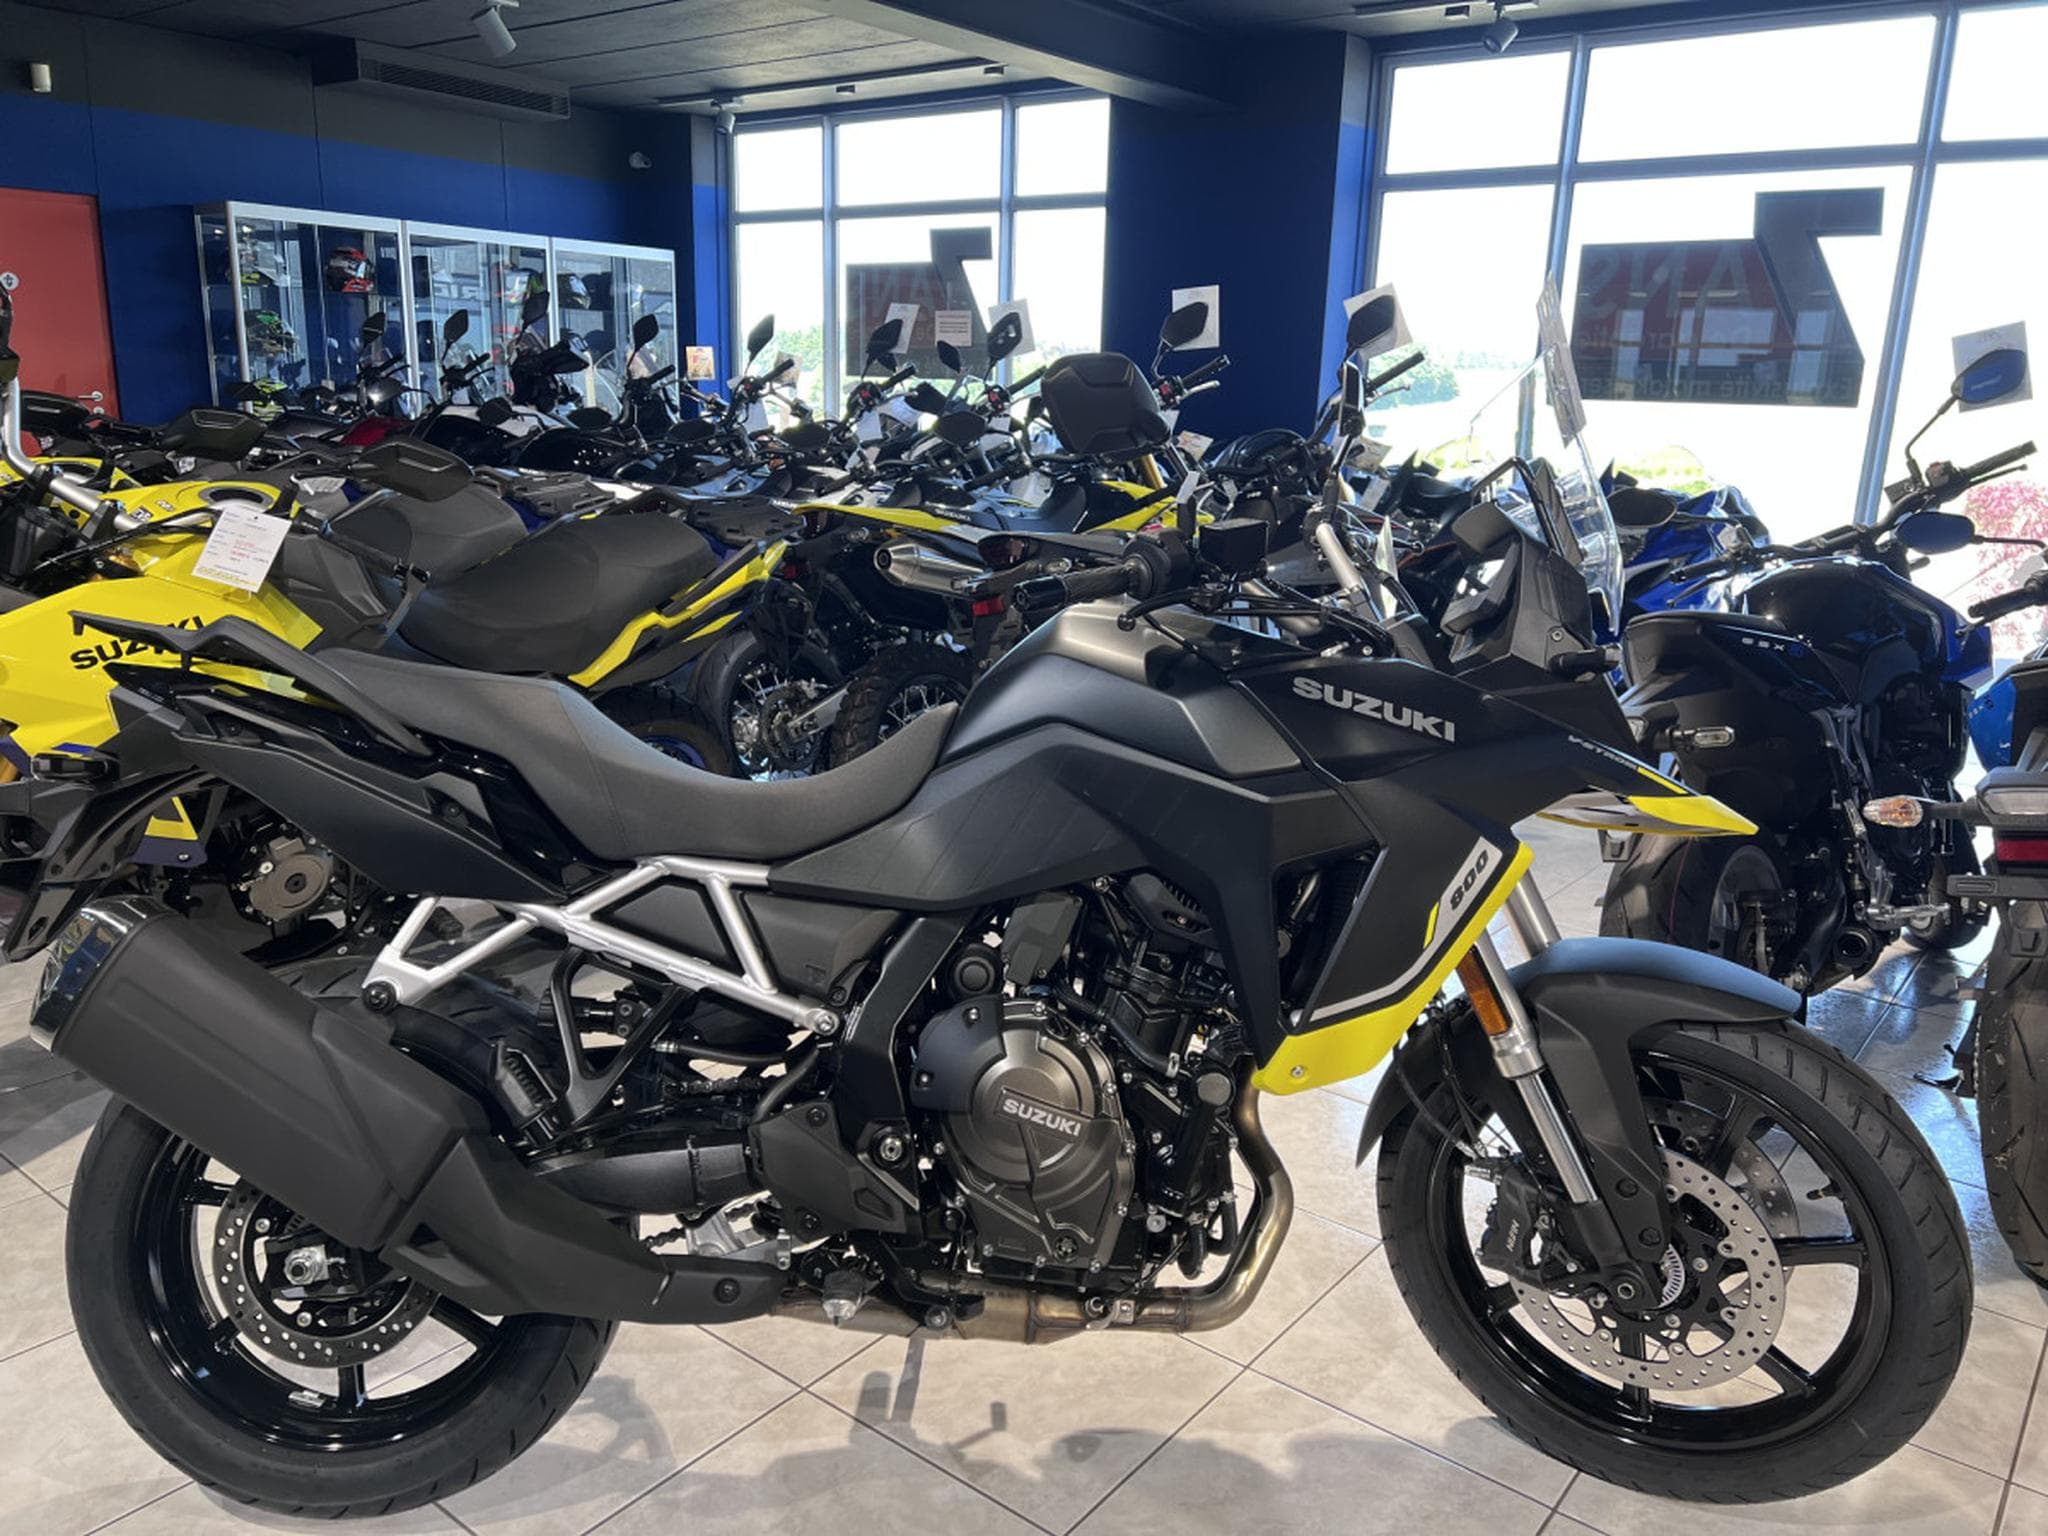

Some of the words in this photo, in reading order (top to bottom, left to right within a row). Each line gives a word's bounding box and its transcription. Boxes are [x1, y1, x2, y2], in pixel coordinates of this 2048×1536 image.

[71, 615, 205, 670] SUZI
[1293, 677, 1455, 742] SUZUKI
[1450, 849, 1489, 911] 800
[1002, 1098, 1082, 1137] SUZUKI
